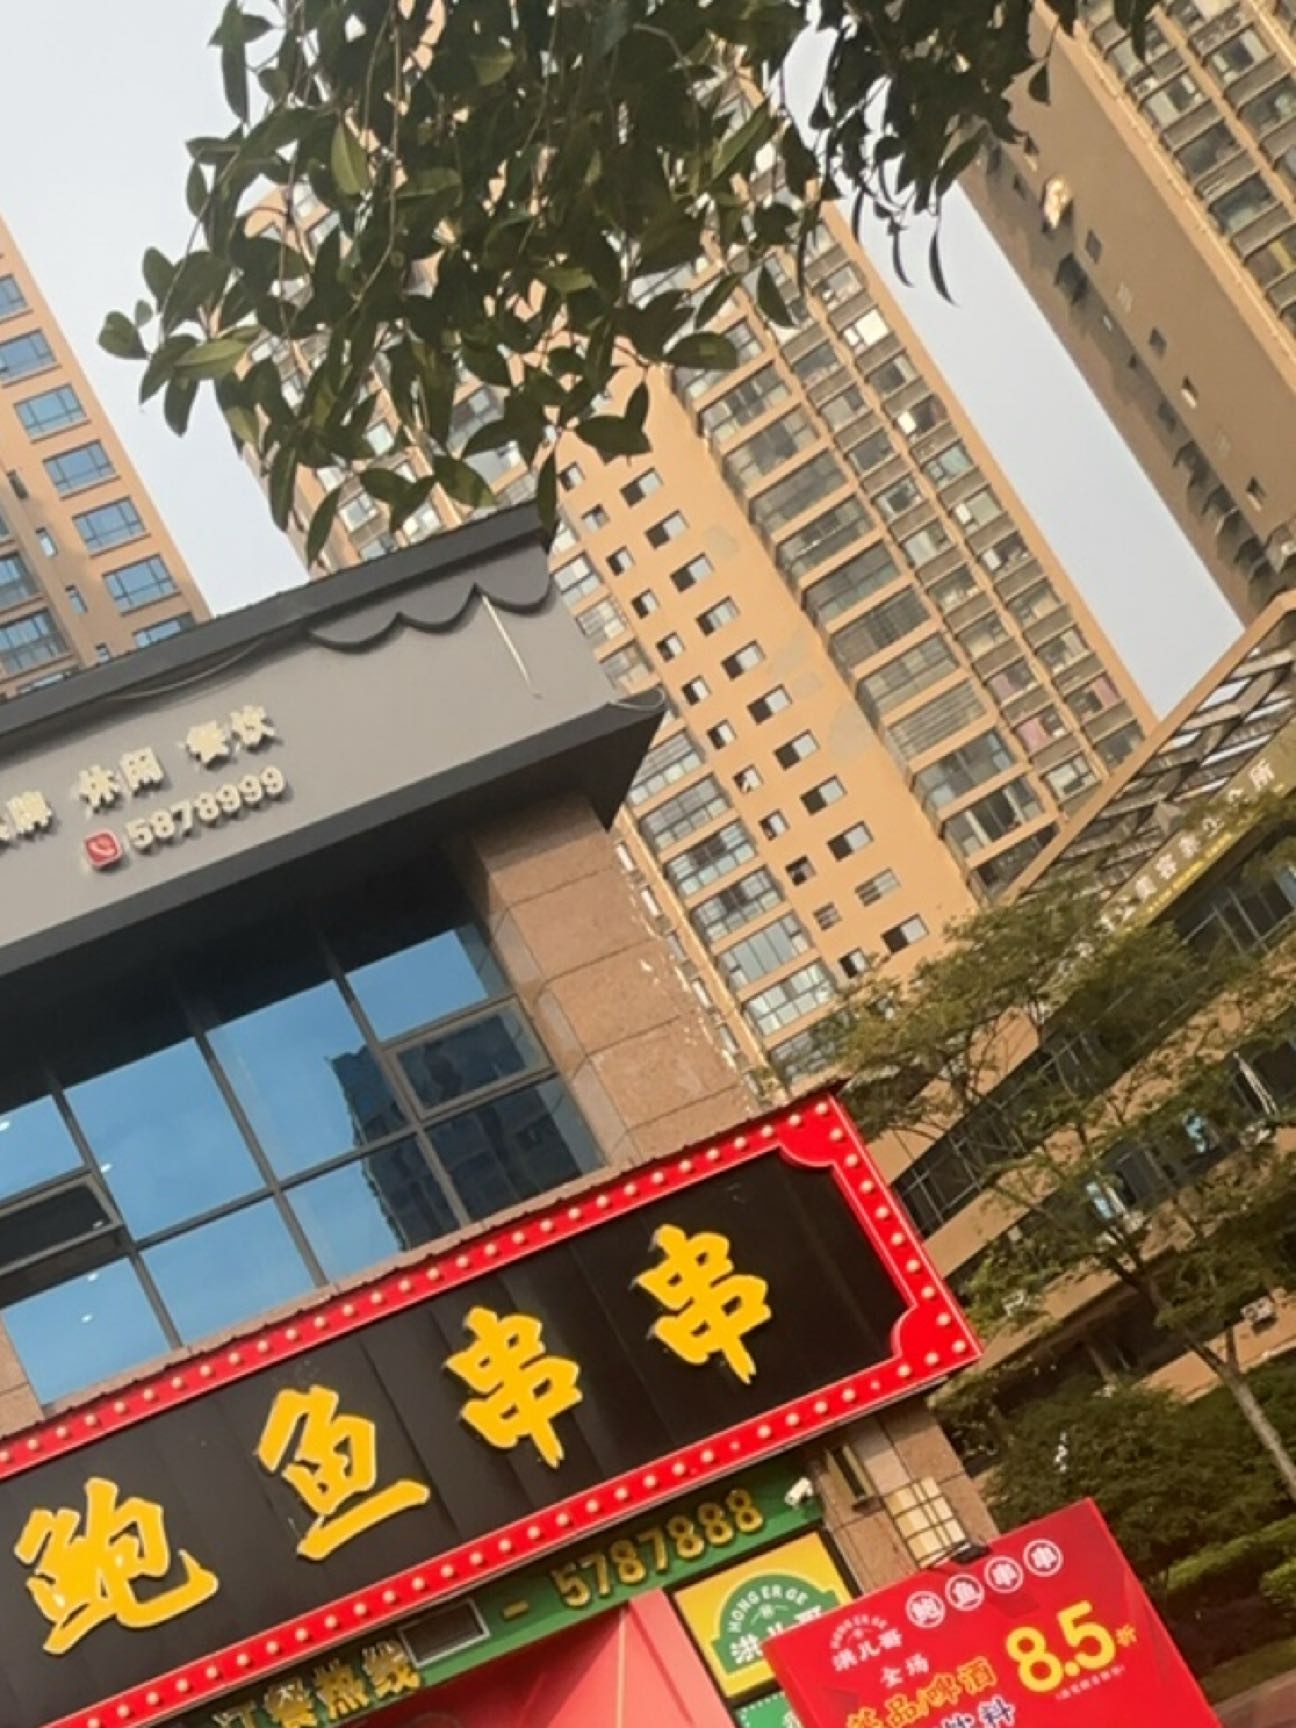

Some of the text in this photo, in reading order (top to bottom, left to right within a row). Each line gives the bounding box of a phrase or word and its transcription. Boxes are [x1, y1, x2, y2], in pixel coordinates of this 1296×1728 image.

[126, 766, 286, 852] 5878999
[14, 1223, 773, 1656] 鲍鱼串串
[550, 1489, 764, 1610] 5787888
